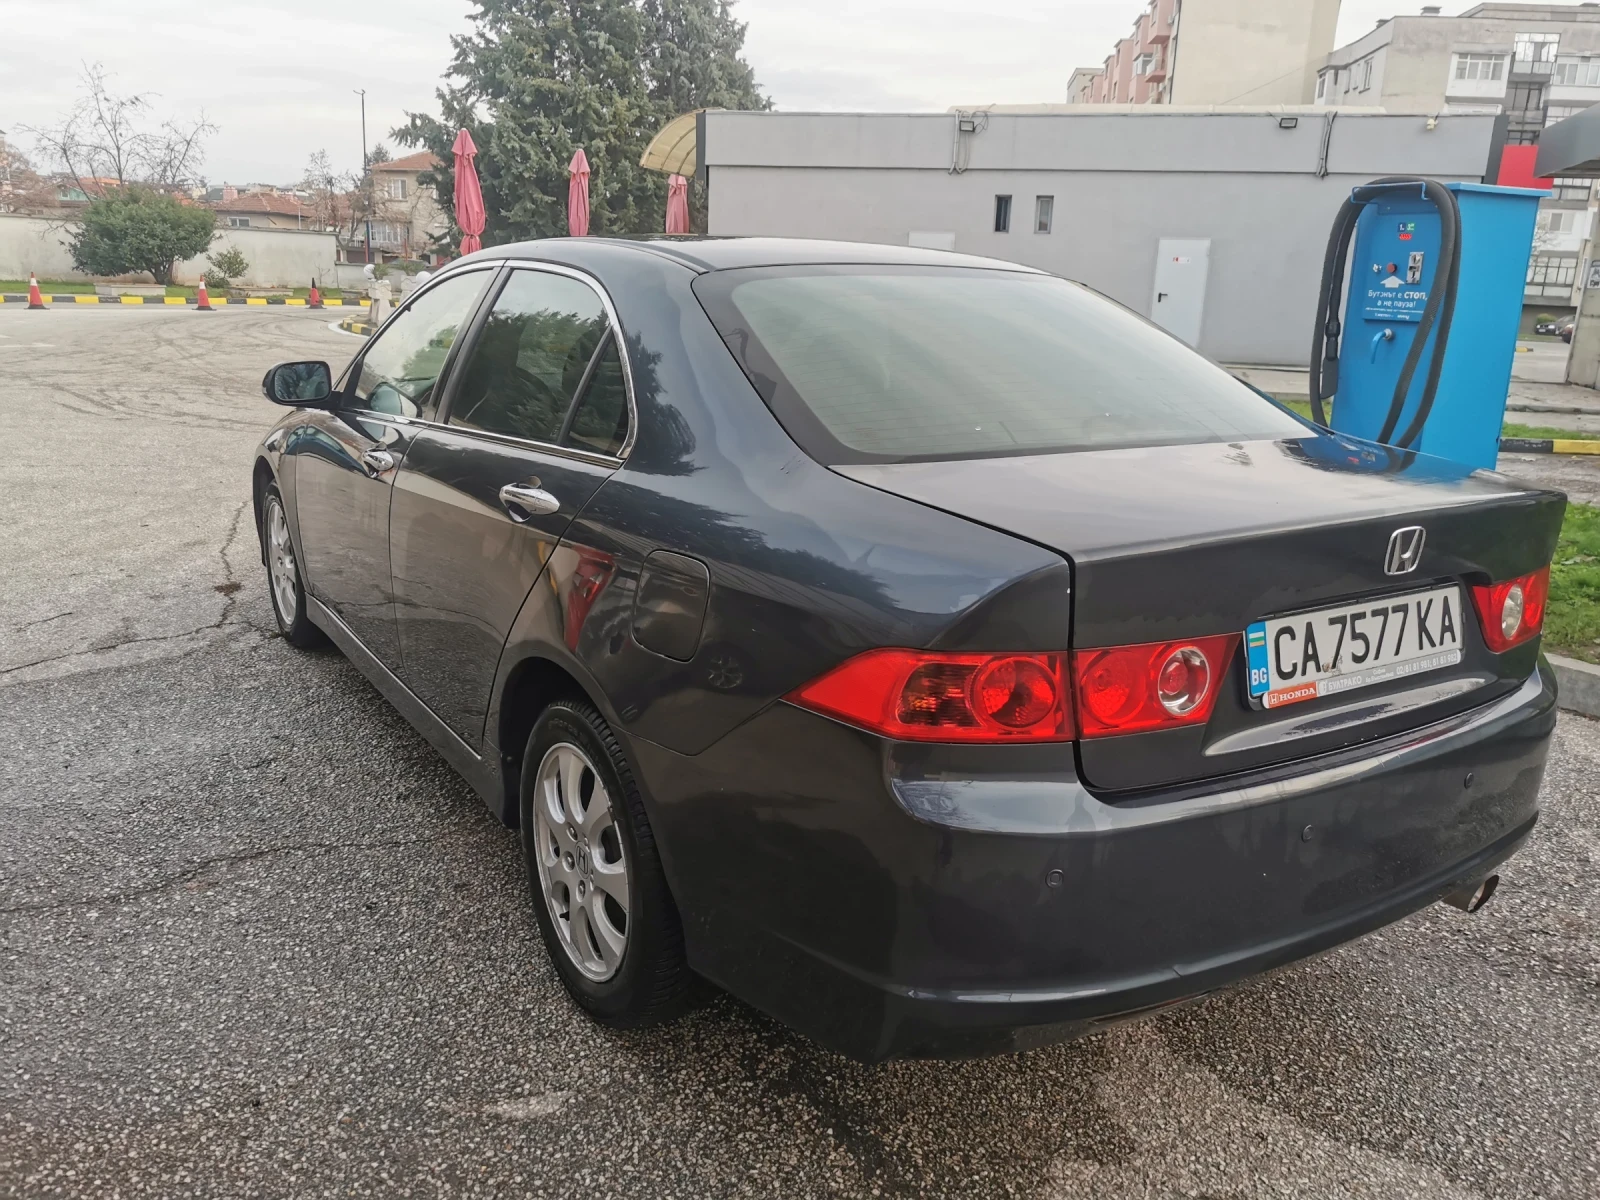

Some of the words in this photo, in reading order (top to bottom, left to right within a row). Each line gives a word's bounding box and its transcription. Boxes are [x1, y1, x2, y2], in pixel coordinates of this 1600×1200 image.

[1328, 603, 1409, 669] 7577
[1251, 667, 1268, 686] BG
[1328, 675, 1362, 691] БУЛТРАКО
[1279, 687, 1316, 702] HONDA
